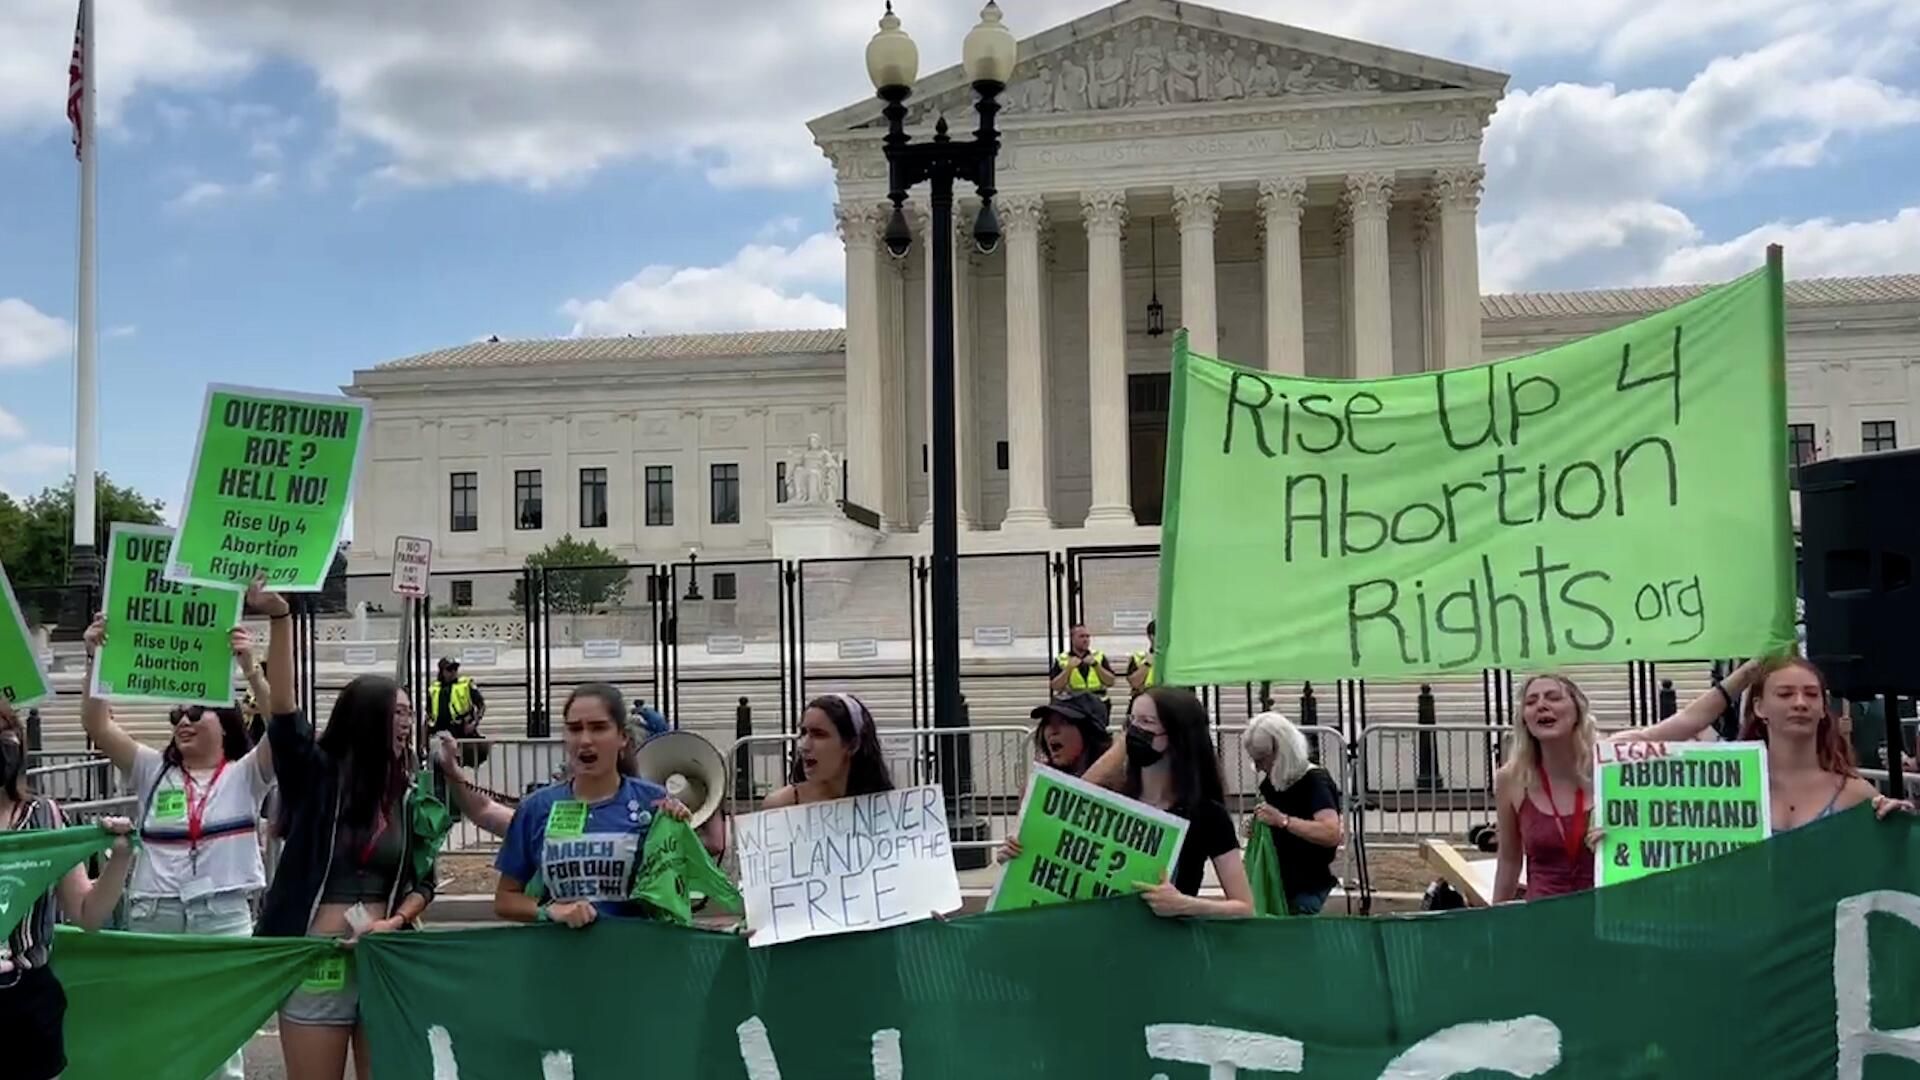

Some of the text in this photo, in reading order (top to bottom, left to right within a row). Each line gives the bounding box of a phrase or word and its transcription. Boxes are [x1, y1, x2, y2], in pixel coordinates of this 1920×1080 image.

[1222, 325, 1682, 458] Rise Up 4
[222, 399, 349, 439] OVERTURN
[243, 436, 318, 469] ROE ?
[218, 468, 329, 505] HELL NO!
[1284, 436, 1678, 563] Abortion
[223, 510, 306, 537] Rise Up 4
[125, 537, 171, 563] OVE
[220, 534, 298, 559] Abortion
[406, 542, 420, 553] NO
[126, 597, 217, 628] HELL NO!
[133, 632, 203, 655] Rise Up 4
[134, 653, 199, 673] Abortion
[127, 673, 206, 698] Rights.org
[1595, 741, 1671, 764] LEGAL
[1619, 759, 1743, 788] ABORTION
[739, 787, 944, 851] WE WERE NEVER
[1042, 785, 1165, 858] OVERTURN
[1607, 799, 1759, 829] ON DEMAND
[546, 841, 614, 862] MARCH
[743, 848, 788, 888] THE
[789, 832, 875, 879] LAND
[1054, 828, 1128, 879] ROE ?
[1613, 842, 1631, 868] &
[547, 860, 625, 881] FOR OUR
[1028, 854, 1083, 899] HELL
[769, 863, 908, 940] FREE
